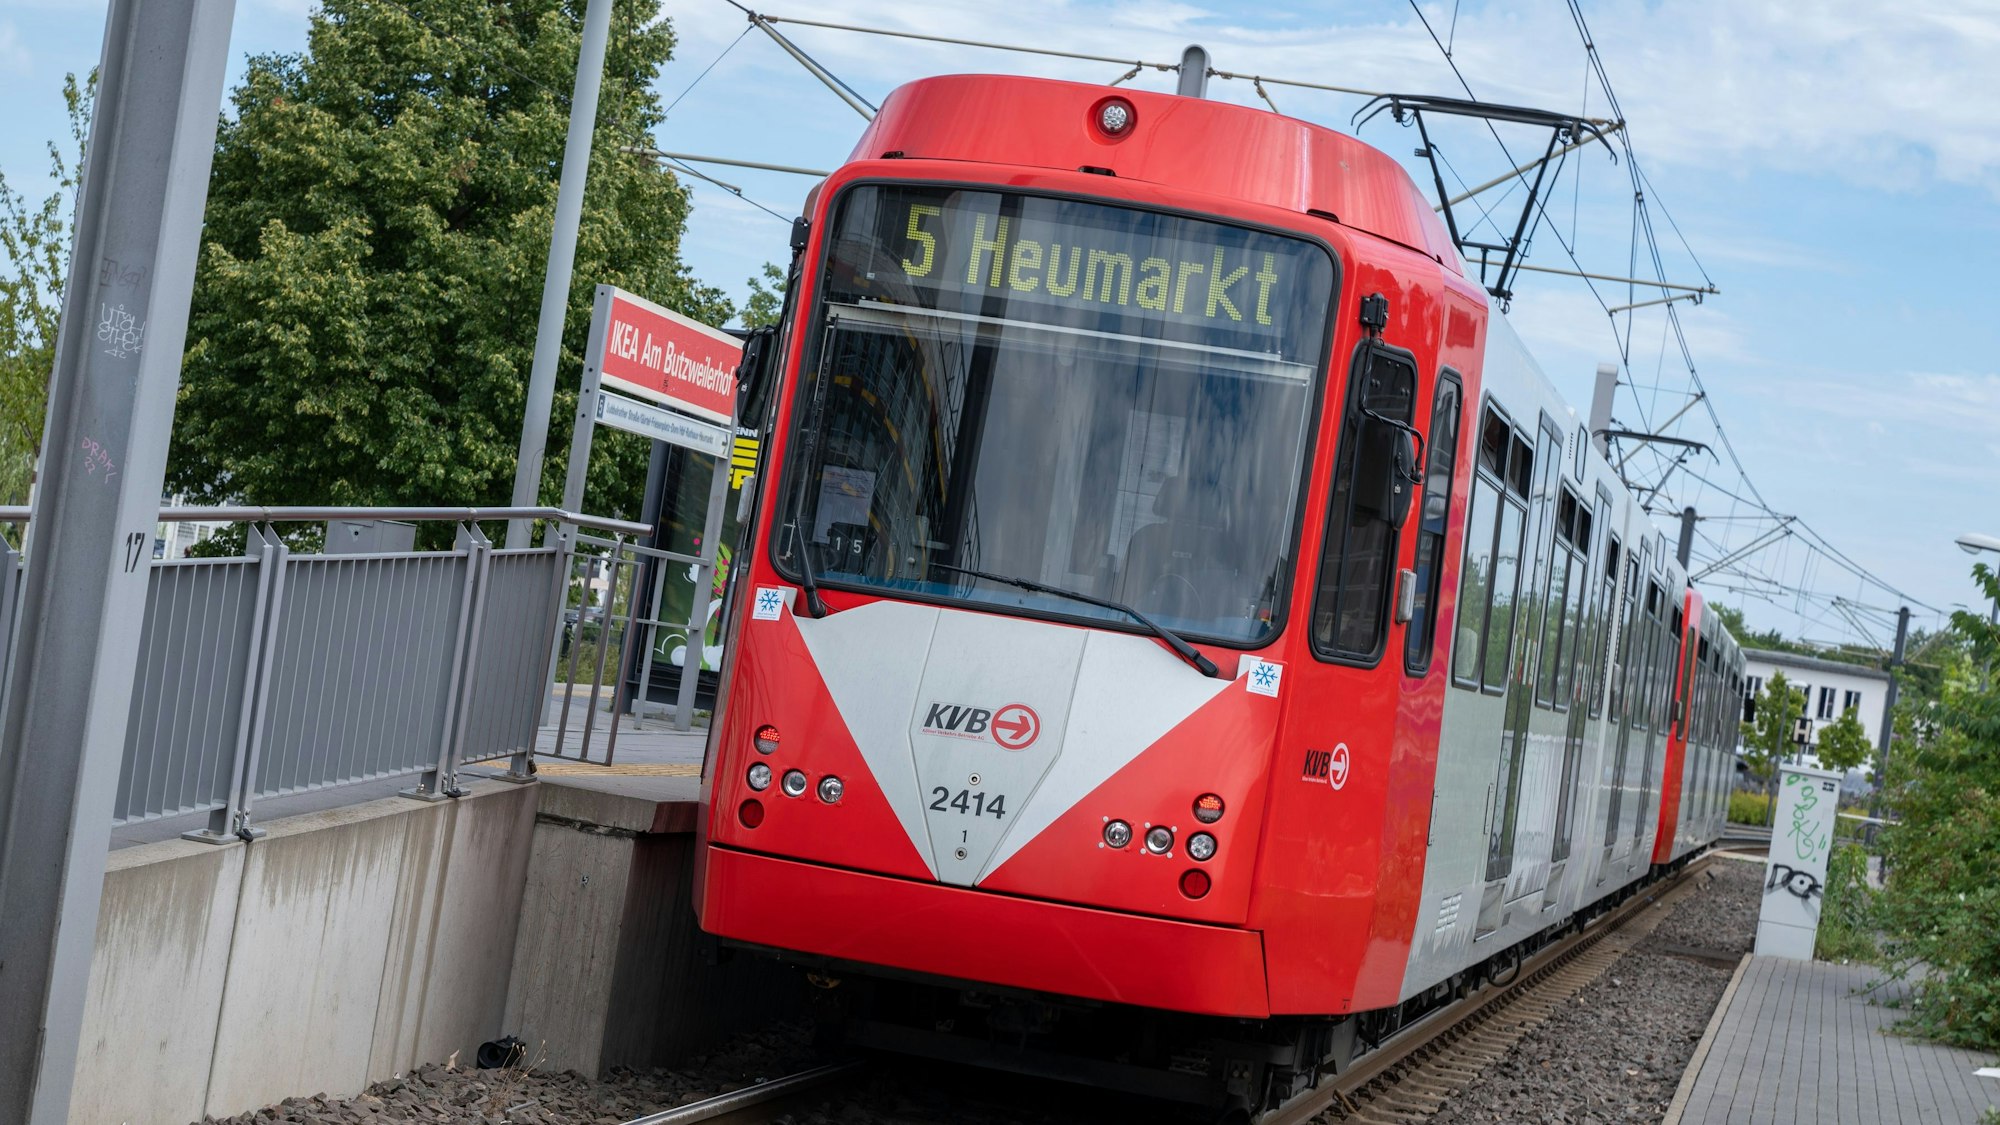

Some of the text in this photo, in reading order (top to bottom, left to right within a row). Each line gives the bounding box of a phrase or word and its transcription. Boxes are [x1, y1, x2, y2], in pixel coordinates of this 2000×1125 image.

[902, 203, 1278, 326] 5 Heumarkt
[609, 319, 639, 362] IKEA
[640, 332, 662, 371] Am
[663, 340, 736, 396] Butzweilerhof
[124, 532, 146, 573] 17
[924, 703, 991, 734] KVB
[1793, 719, 1811, 743] H
[1303, 749, 1331, 777] KVB
[929, 786, 1006, 820] 2414
[962, 829, 968, 843] 1
